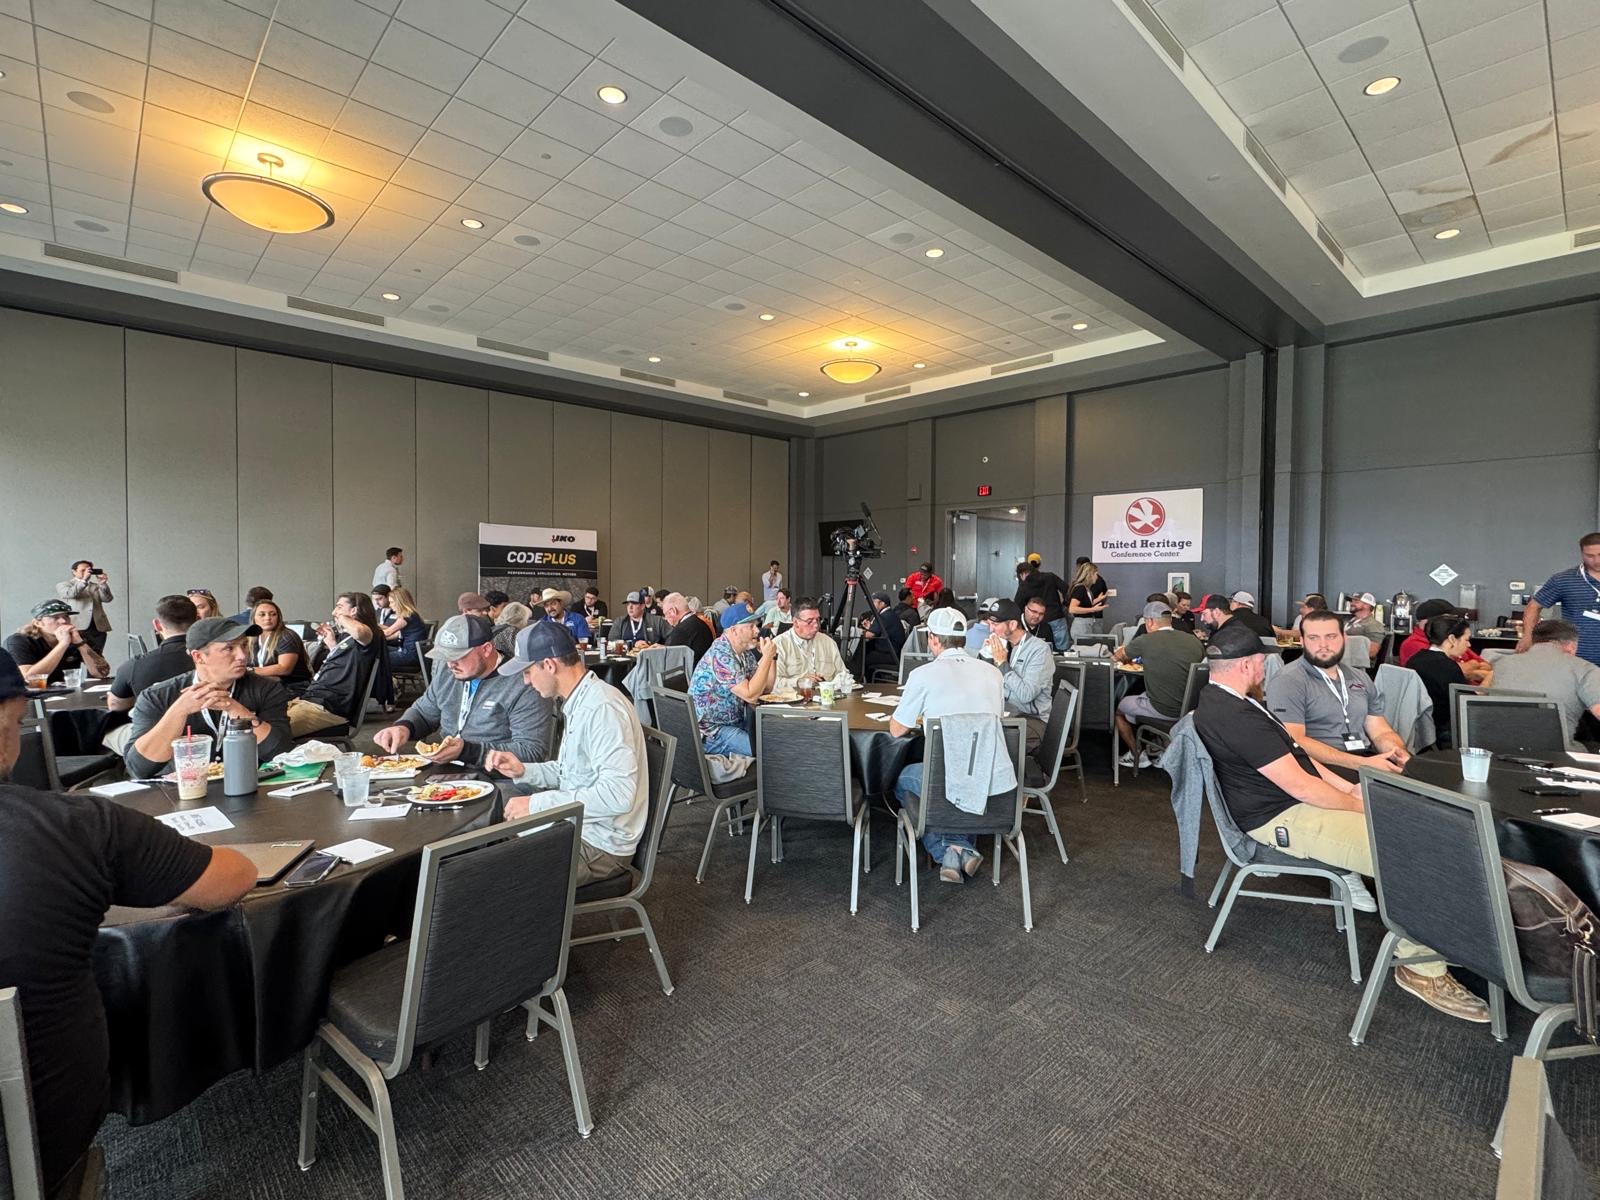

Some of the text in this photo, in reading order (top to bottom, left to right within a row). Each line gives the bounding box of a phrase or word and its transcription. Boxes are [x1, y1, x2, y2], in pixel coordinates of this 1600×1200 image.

[979, 486, 990, 495] EXIT
[1101, 539, 1193, 550] United Heritage
[507, 551, 577, 565] CODEPLUS
